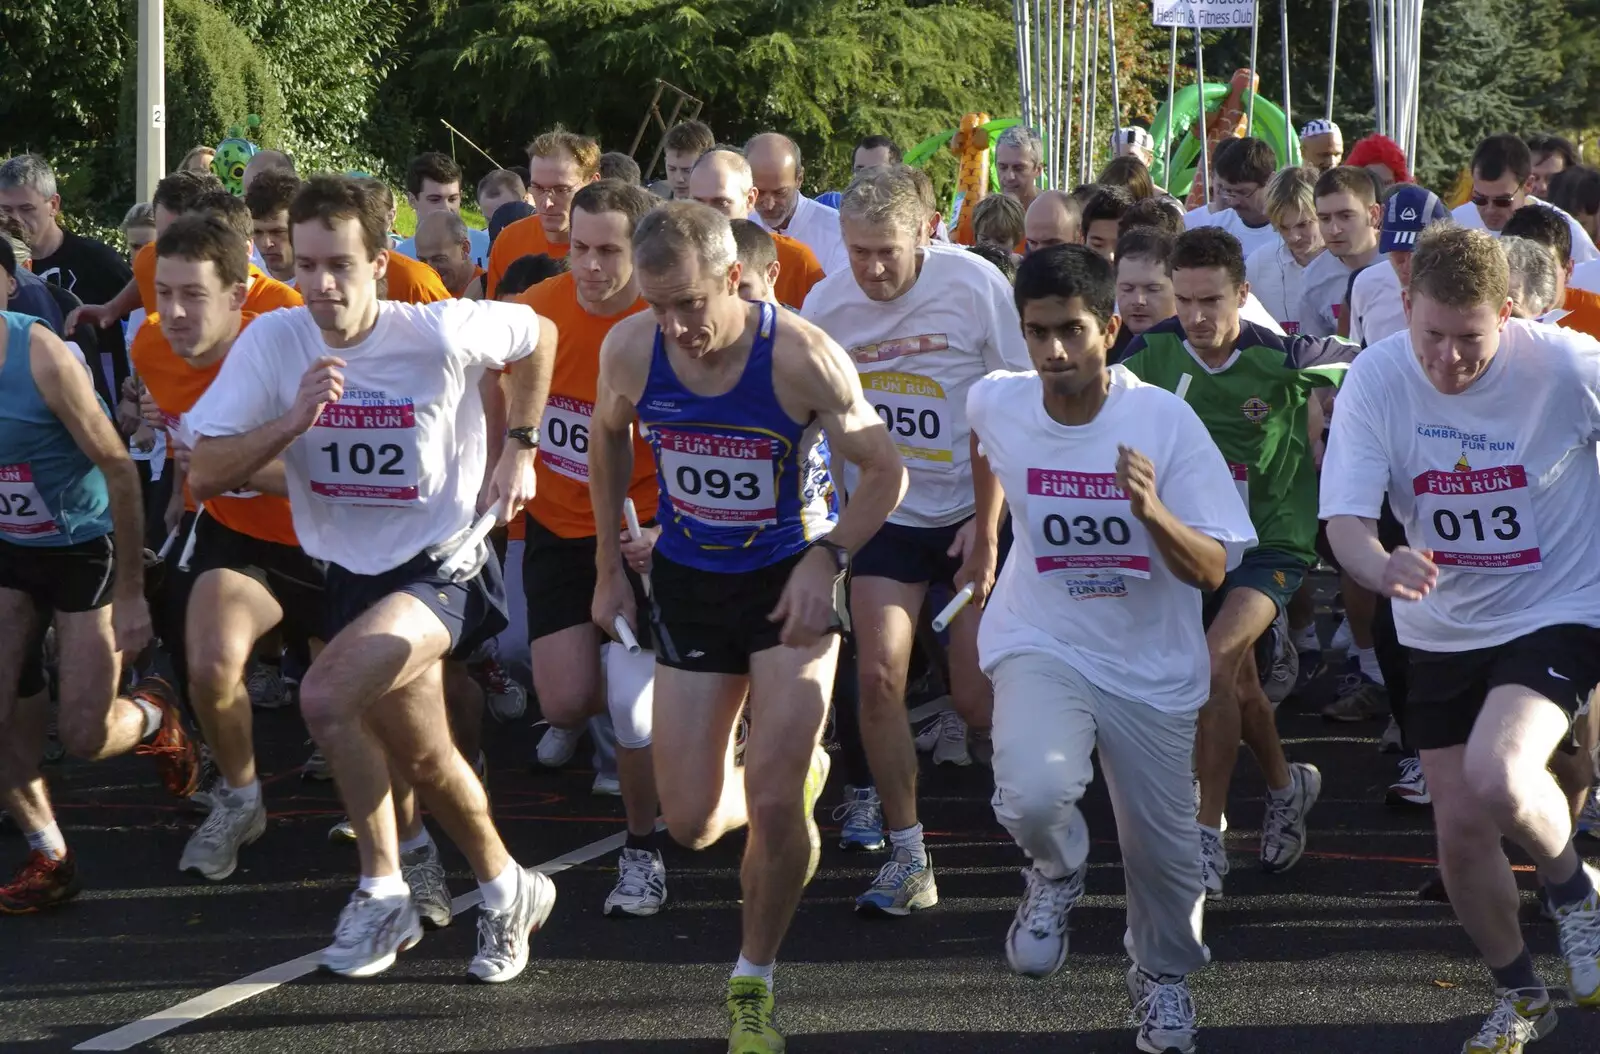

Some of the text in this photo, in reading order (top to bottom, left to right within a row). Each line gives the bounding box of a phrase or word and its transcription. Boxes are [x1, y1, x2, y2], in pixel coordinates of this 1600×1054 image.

[1157, 8, 1253, 25] Health & Fitness Club
[871, 379, 901, 392] FUN
[906, 383, 937, 396] RUN
[322, 407, 401, 416] AMBRIDGE
[320, 413, 402, 428] FUN RUN
[874, 403, 941, 440] 050
[1417, 426, 1487, 442] CAMBRIDGE
[673, 440, 758, 459] FUN RUN
[1461, 440, 1516, 452] FUN RUN
[321, 442, 405, 475] 102
[676, 465, 761, 501] 093
[1427, 468, 1511, 482] CAMBRIDGE
[1040, 480, 1125, 498] FUN RUN
[1427, 476, 1512, 494] FUN RUN
[1043, 513, 1131, 546] 030
[1432, 505, 1522, 542] 013
[1459, 552, 1492, 561] CHILDREN
[1502, 552, 1522, 560] NEED
[1485, 559, 1510, 568] Smile!
[1068, 585, 1096, 597] FUN
[1098, 582, 1127, 594] RUN
